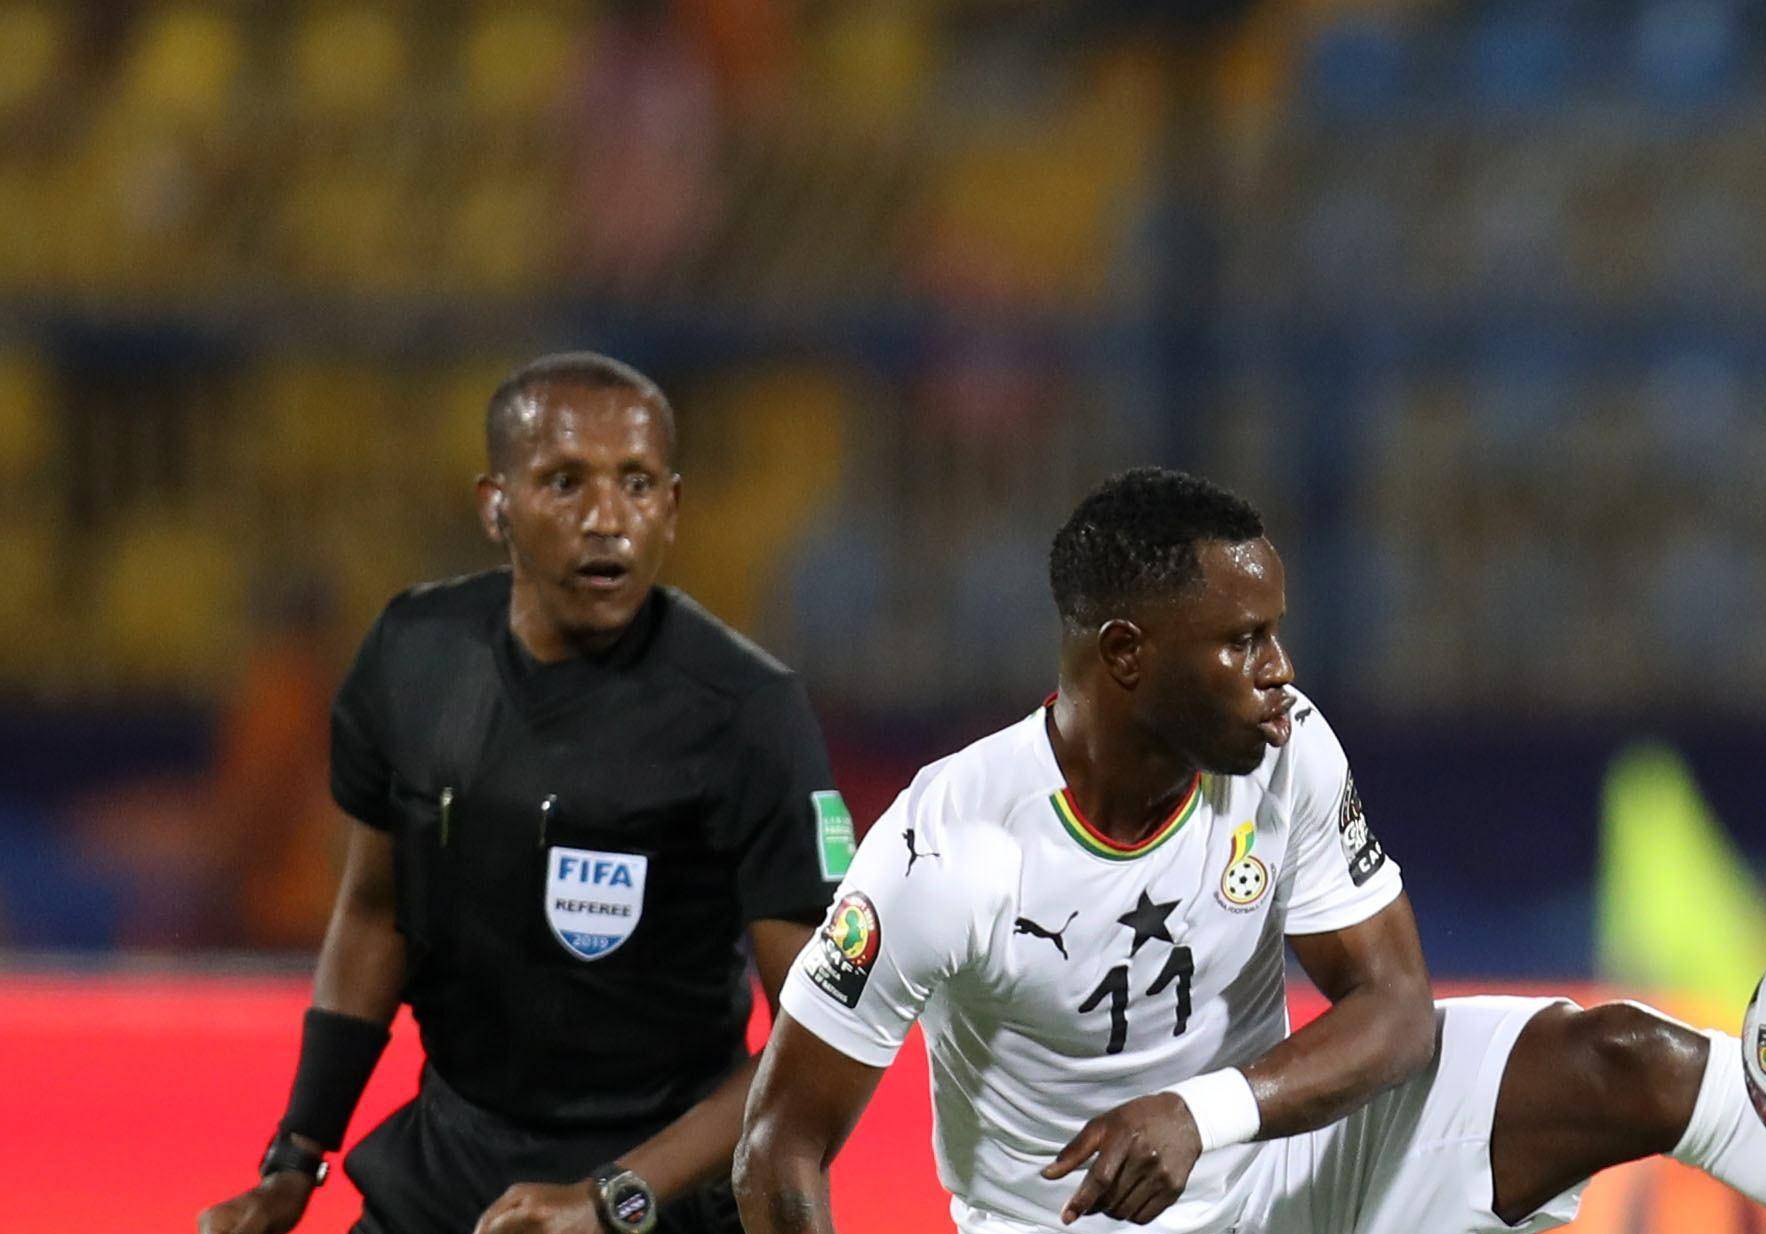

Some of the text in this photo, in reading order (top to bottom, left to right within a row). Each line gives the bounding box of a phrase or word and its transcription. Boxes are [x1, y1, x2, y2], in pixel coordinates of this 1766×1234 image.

[558, 857, 632, 887] FIFA
[556, 899, 632, 917] REFEREE
[574, 933, 609, 947] 2019
[1078, 946, 1195, 1054] 11
